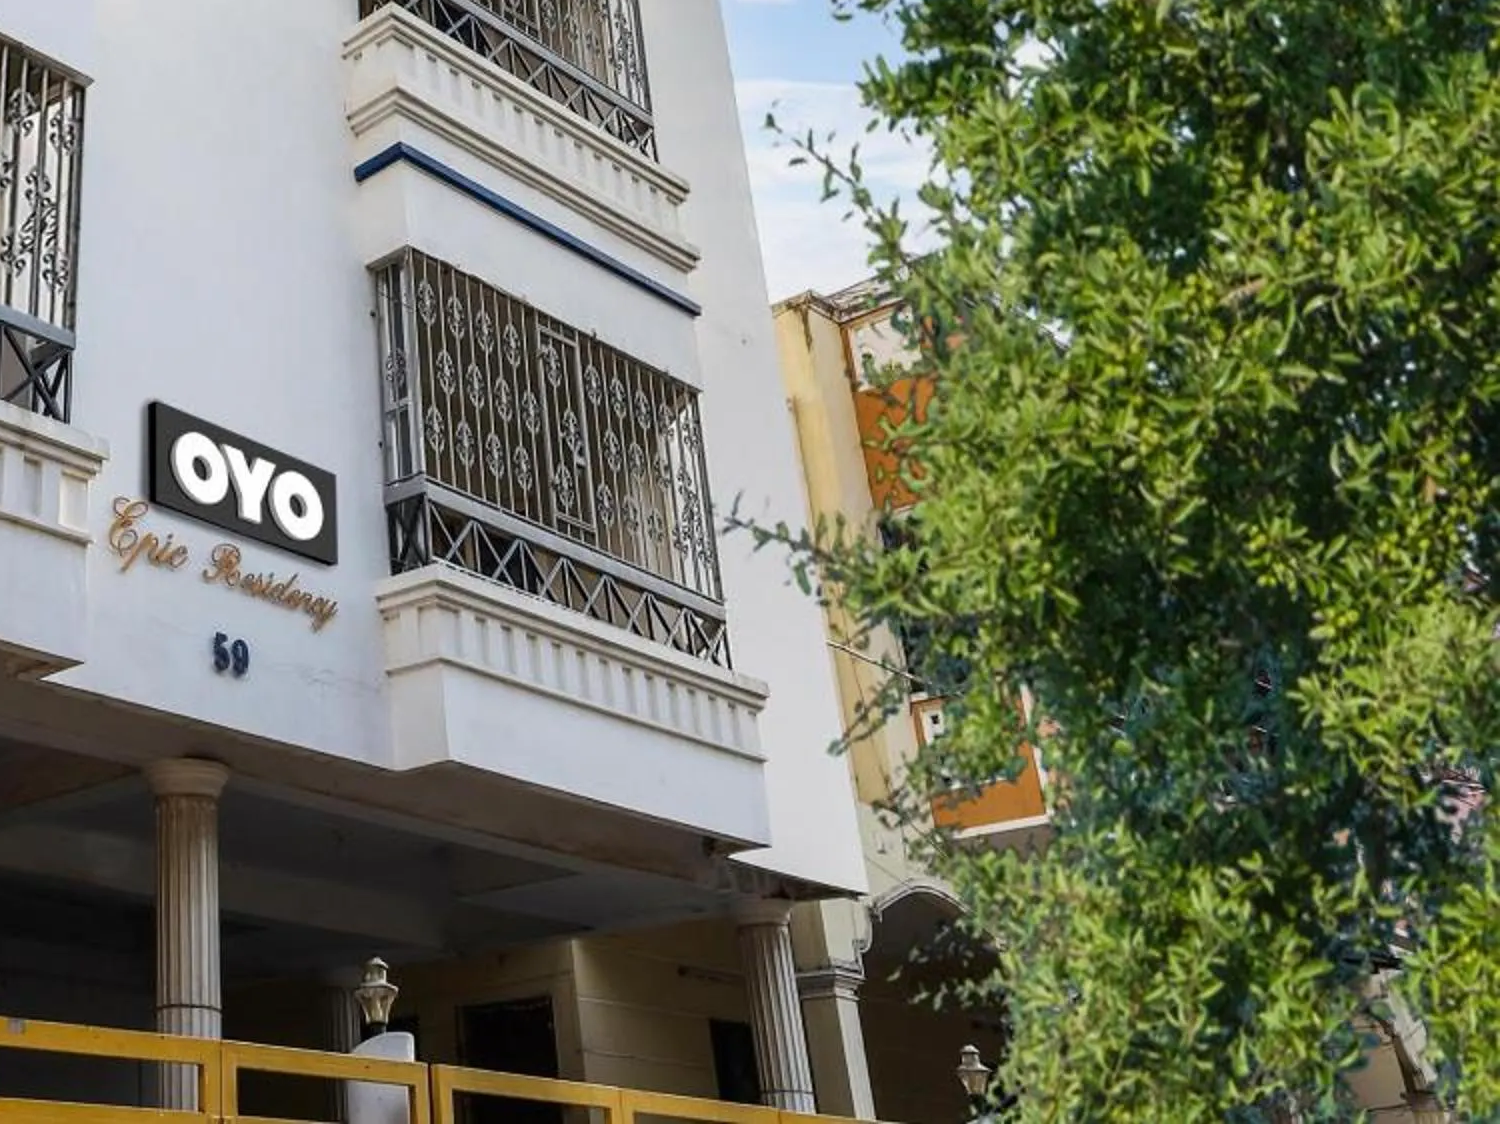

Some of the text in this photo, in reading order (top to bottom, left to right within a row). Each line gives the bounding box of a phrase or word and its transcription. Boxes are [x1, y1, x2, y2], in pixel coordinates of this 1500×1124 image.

[172, 431, 324, 541] OYO
[109, 497, 338, 632] Epic Residency
[213, 631, 250, 677] 59
